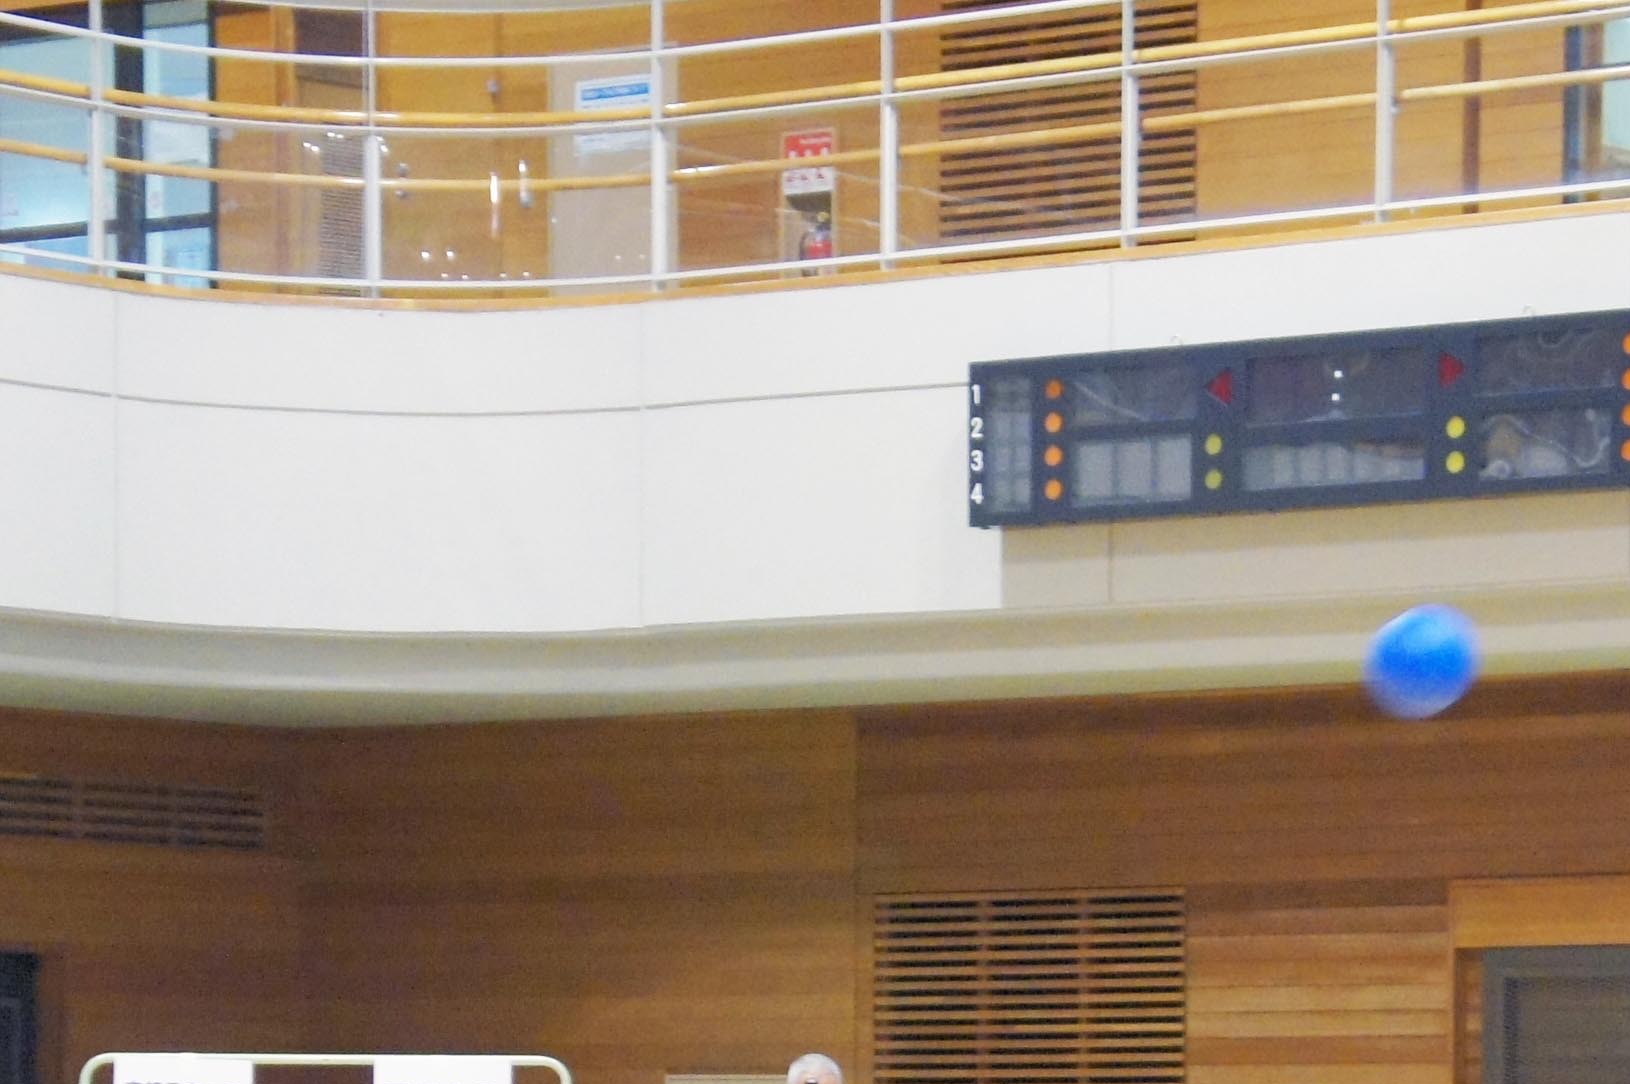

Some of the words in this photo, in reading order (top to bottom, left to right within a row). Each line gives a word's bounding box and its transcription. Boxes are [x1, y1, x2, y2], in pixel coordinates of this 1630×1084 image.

[971, 384, 981, 404] 1
[970, 417, 984, 438] 2
[970, 450, 984, 471] 3
[970, 483, 984, 504] 4
